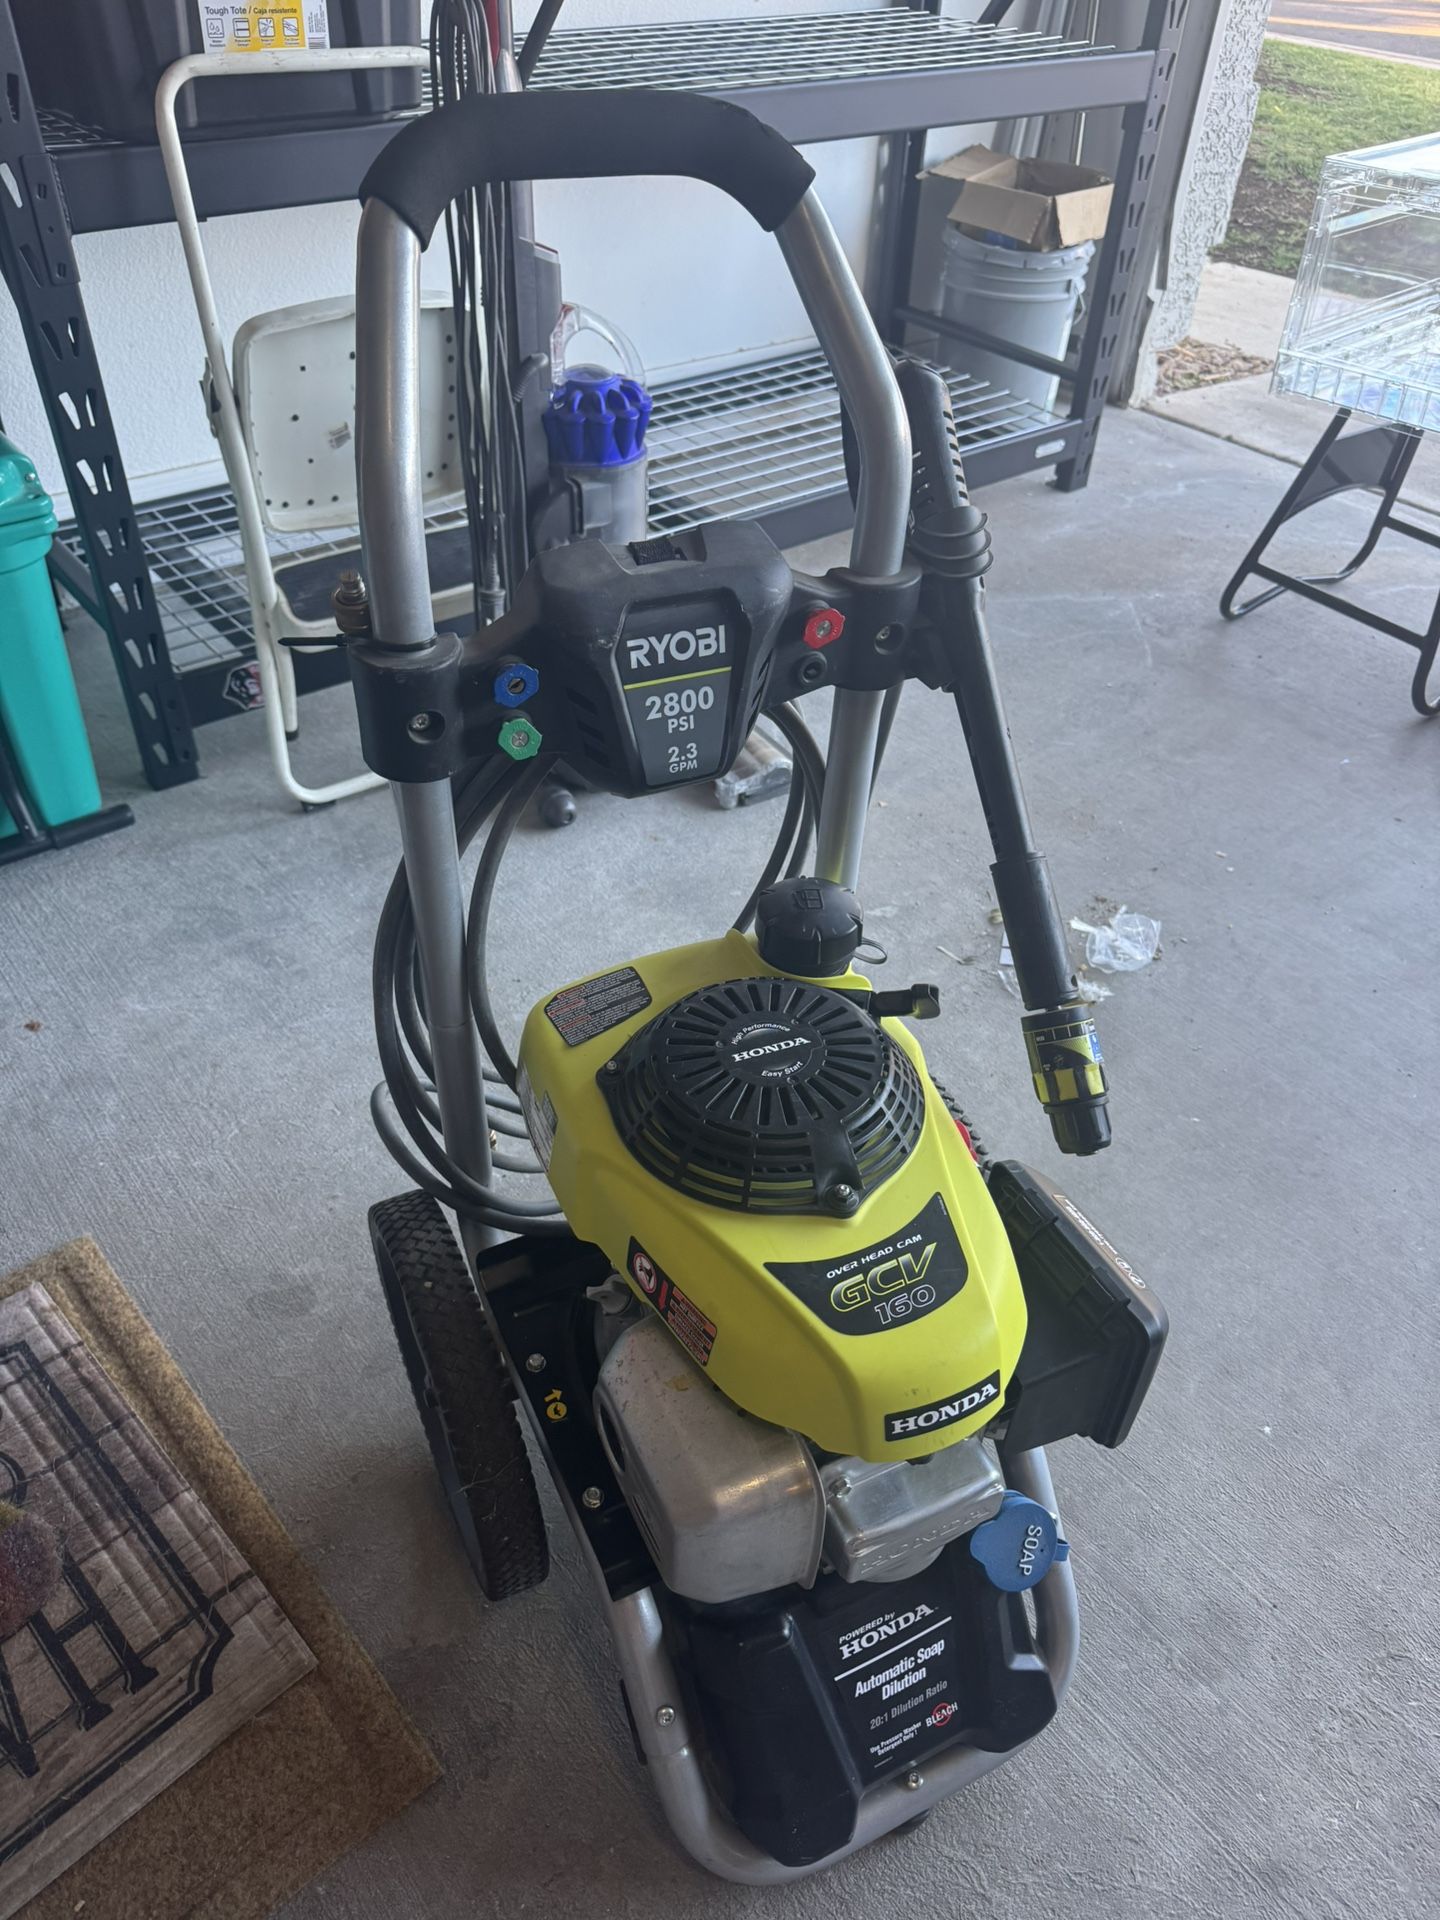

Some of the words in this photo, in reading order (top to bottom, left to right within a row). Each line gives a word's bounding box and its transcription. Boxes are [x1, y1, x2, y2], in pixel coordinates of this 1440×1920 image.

[205, 6, 229, 16] Tough
[230, 6, 247, 14] Tote
[627, 624, 726, 669] RYOBI
[645, 686, 714, 721] 2800
[668, 715, 695, 734] PSI
[668, 743, 698, 763] 2.3
[669, 761, 698, 774] GPM
[731, 1032, 744, 1045] High
[742, 1023, 791, 1033] Performance
[731, 1037, 812, 1063] HONDA
[784, 1061, 804, 1075] Start
[826, 1261, 859, 1279] OVER
[861, 1246, 894, 1265] HEAD
[896, 1234, 923, 1249] CAM
[830, 1242, 938, 1313] GCV
[873, 1284, 936, 1325] 160
[891, 1383, 998, 1435] HONDA
[1018, 1524, 1043, 1576] SOAP
[839, 1617, 884, 1644] POWERED
[884, 1611, 896, 1621] by
[839, 1604, 934, 1660] HONDA
[855, 1656, 916, 1698] Automatic
[917, 1639, 945, 1664] Soap
[881, 1667, 927, 1700] Dilution
[869, 1714, 889, 1730] 20:1
[890, 1693, 924, 1719] Dilution
[925, 1680, 948, 1700] Ratio
[925, 1702, 958, 1727] BLEACH
